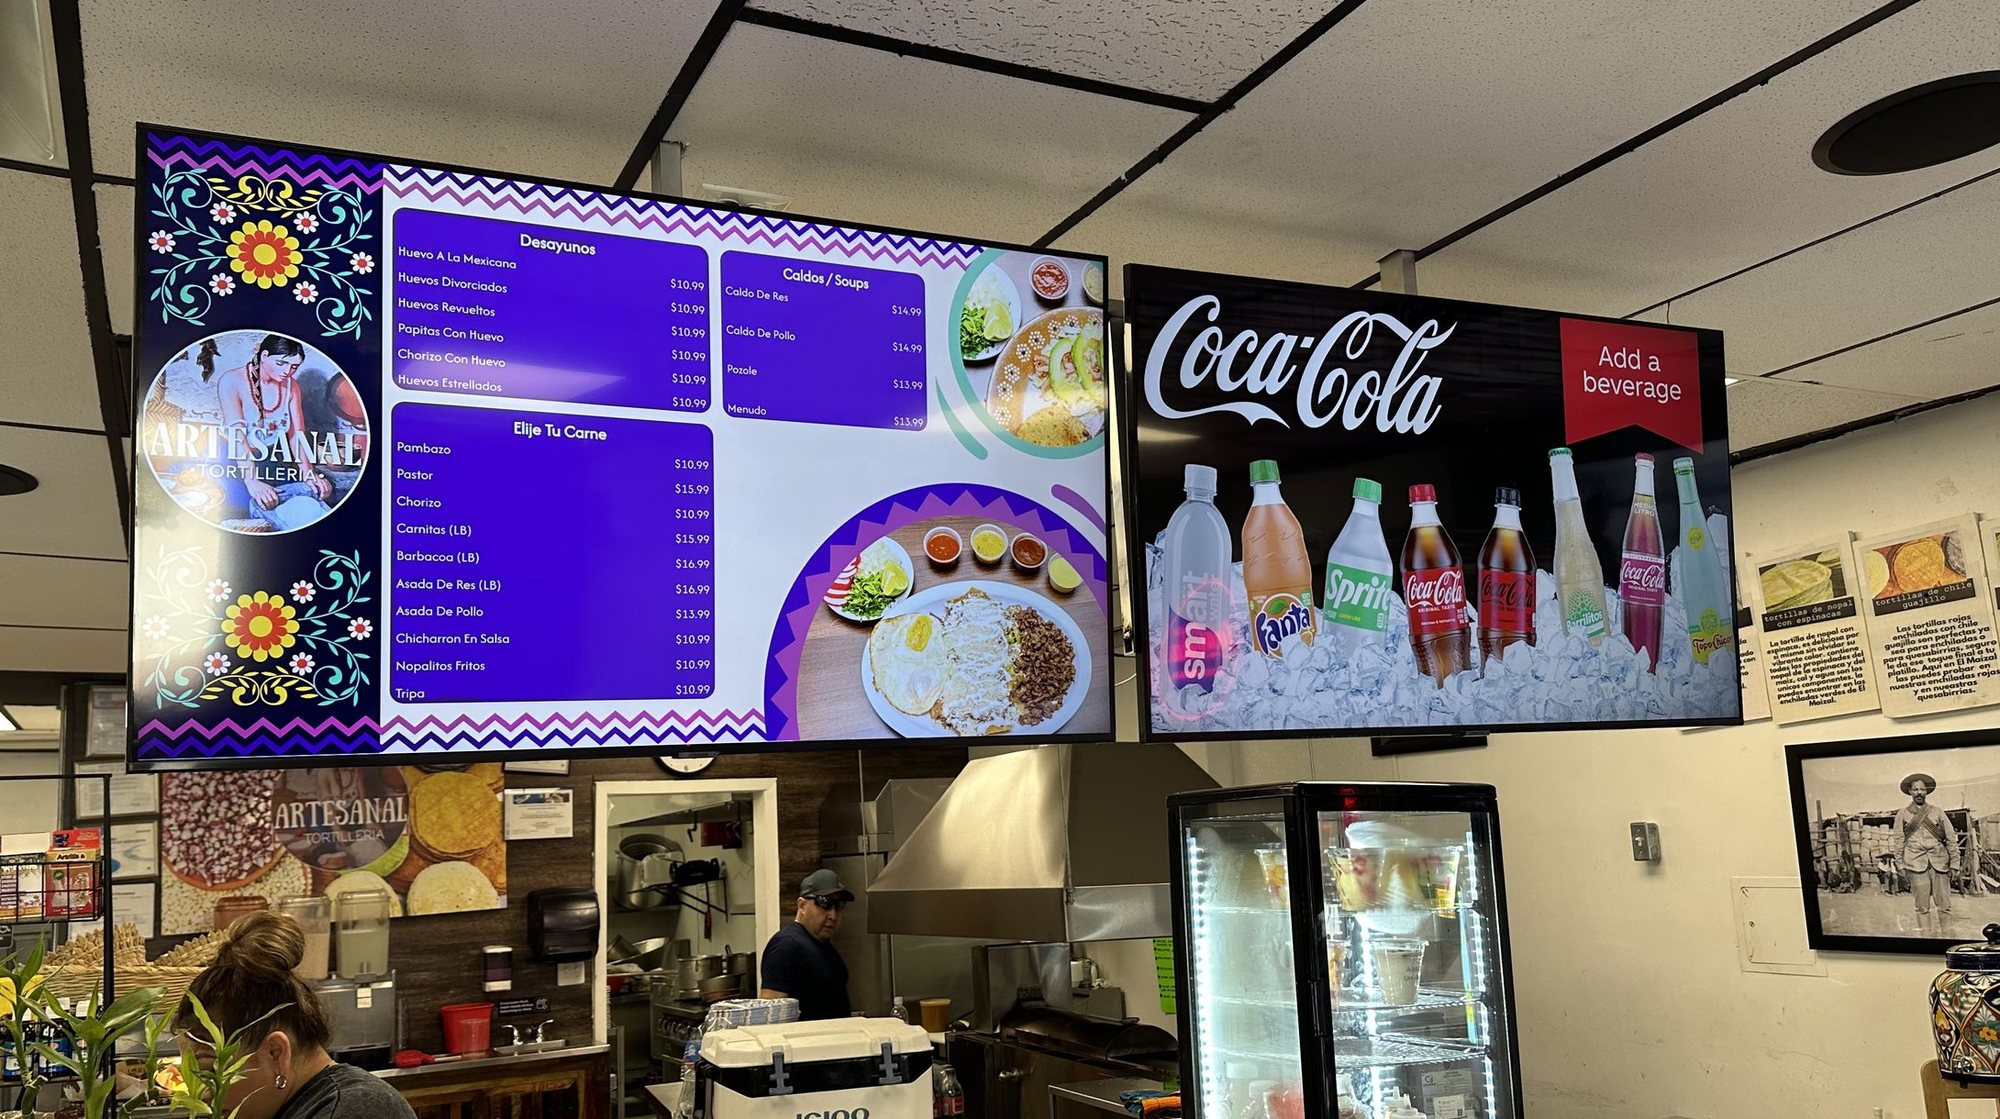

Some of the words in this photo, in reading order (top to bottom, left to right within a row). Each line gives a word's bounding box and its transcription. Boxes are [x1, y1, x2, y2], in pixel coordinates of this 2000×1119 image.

[521, 234, 596, 255] Desayunos
[399, 246, 433, 259] Huevo
[437, 251, 444, 260] A
[448, 252, 460, 262] La
[464, 254, 516, 268] Mexicana
[671, 279, 704, 291] $10.99
[783, 268, 824, 284] Caldos
[826, 273, 833, 286] /
[835, 274, 869, 291] Soups
[399, 272, 438, 287] Huevos
[442, 277, 507, 293] Divorciados
[671, 302, 705, 314] $10.99
[726, 286, 754, 297] Caldo
[757, 290, 770, 299] De
[773, 292, 788, 301] Res
[892, 305, 921, 316] $14.99
[399, 298, 438, 312] Huevos
[442, 302, 495, 316] Revueltos
[672, 326, 705, 338] $10.99
[399, 323, 440, 338] Papitas
[443, 328, 466, 340] Con
[470, 330, 504, 342] Huevo
[672, 350, 706, 361] $10.99
[726, 325, 755, 336] Caldo
[758, 328, 771, 338] De
[774, 330, 795, 340] Pollo
[893, 342, 922, 353] $14.99
[398, 349, 441, 361] Chorizo
[445, 353, 468, 363] Con
[472, 355, 505, 367] Huevo
[672, 373, 706, 385] $10.99
[1143, 294, 1458, 434] Coca-Cola
[1599, 345, 1641, 371] Add
[1648, 356, 1661, 372] a
[728, 364, 757, 375] Pozole
[894, 379, 923, 390] $13.99
[1582, 369, 1682, 404] beverage
[398, 374, 439, 388] Huevos
[442, 378, 502, 392] Estrellados
[672, 397, 707, 409] $10.99
[728, 404, 766, 415] Menudo
[894, 416, 923, 427] $13.99
[514, 421, 541, 438] Elije
[545, 424, 560, 437] Tu
[564, 426, 607, 441] Carne
[150, 423, 362, 466] ARTESANAL
[398, 442, 451, 454] Pambazo
[675, 459, 709, 470] $10.99
[200, 464, 315, 482] TORTILLERIA
[398, 469, 433, 480] Pastor
[676, 484, 709, 494] $15.99
[397, 496, 441, 507] Chorizo
[676, 509, 709, 521] $10.99
[1634, 508, 1655, 516] LITRO
[397, 523, 445, 534] Carnitas
[449, 525, 471, 537] (LB)
[676, 534, 709, 545] $15.99
[397, 551, 453, 562] Barbacoa
[457, 552, 479, 564] (LB)
[676, 559, 710, 570] $16.99
[1622, 560, 1665, 589] Coca-Cola
[396, 579, 433, 589] Asada
[437, 580, 453, 589] De
[457, 580, 476, 590] Res
[479, 580, 501, 592] (LB)
[676, 584, 710, 594] $16.99
[1327, 568, 1391, 611] Sprite
[1407, 570, 1464, 608] Coca-Cola
[1876, 592, 1922, 605] tortillas
[1944, 582, 1971, 592] chile
[396, 606, 432, 616] Asada
[437, 606, 453, 616] De
[457, 606, 483, 616] Pollo
[676, 609, 710, 619] $13.99
[1764, 610, 1807, 621] tortillas
[1827, 599, 1852, 610] nopal
[1902, 595, 1945, 609] guajillo
[1184, 570, 1208, 680] smart
[1796, 611, 1840, 623] espinacas
[1913, 619, 1946, 629] tortillas
[1948, 615, 1971, 623] rojas
[396, 633, 461, 643] Chicharron
[464, 634, 477, 643] En
[481, 634, 509, 643] Salsa
[676, 634, 710, 645] $10.99
[1256, 602, 1311, 656] Fanta
[1780, 636, 1804, 644] tortilla
[1817, 627, 1838, 638] nopal
[1884, 638, 1915, 650] guajillo
[1935, 629, 1976, 641] perfectas
[1892, 628, 1938, 640] enchiladas
[1957, 620, 1977, 628] chile
[1693, 637, 1713, 652] Topo
[1712, 634, 1733, 648] Chico
[1883, 656, 1903, 664] para
[1905, 646, 1963, 660] quesabirrias,
[1965, 640, 1996, 649] seguro
[1907, 644, 1928, 653] para
[1930, 636, 1977, 647] enchiladas
[1955, 649, 1975, 658] final
[396, 660, 452, 673] Nopalitos
[456, 661, 485, 670] Fritos
[676, 660, 710, 670] $10.99
[1888, 667, 1919, 677] platillo.
[1966, 653, 1997, 663] Maizal
[1910, 671, 1940, 681] puedes
[1943, 666, 1974, 676] probar
[1890, 681, 1926, 690] nuestras
[1928, 673, 1975, 684] enchiladas
[1977, 667, 2000, 677] rojas
[395, 688, 425, 701] Tripa
[676, 685, 710, 695] $10.99
[1917, 688, 1975, 700] quesabirrias.
[274, 797, 407, 829] ARTESANAL
[305, 830, 384, 844] TORTILLERIA
